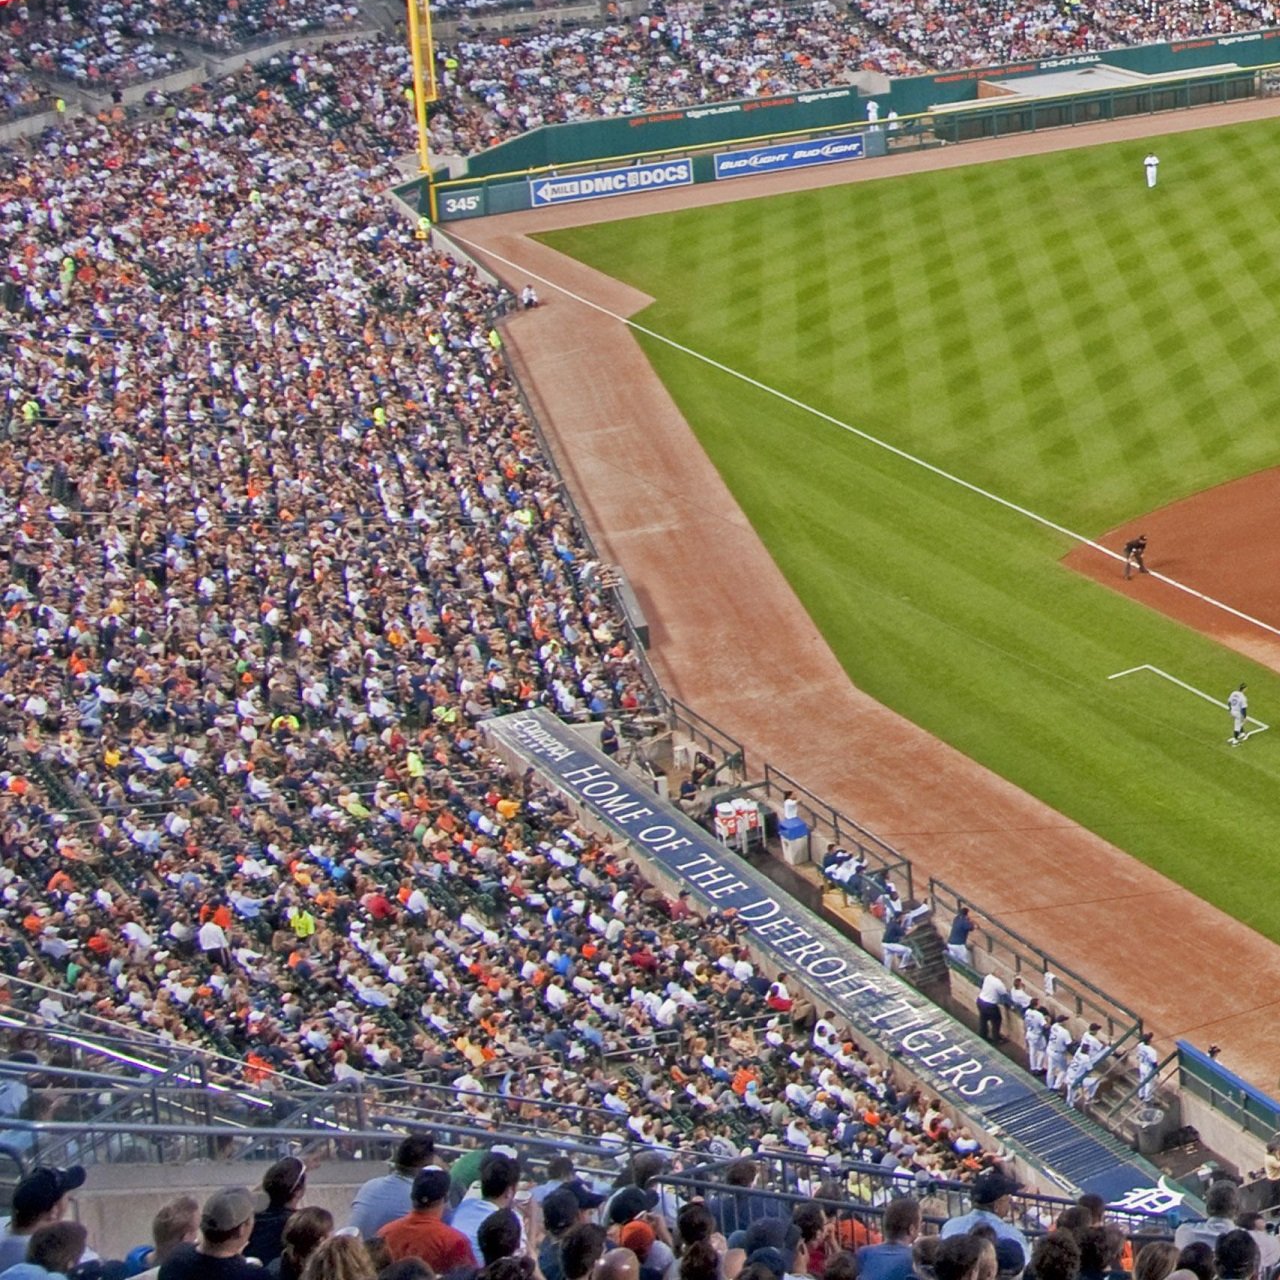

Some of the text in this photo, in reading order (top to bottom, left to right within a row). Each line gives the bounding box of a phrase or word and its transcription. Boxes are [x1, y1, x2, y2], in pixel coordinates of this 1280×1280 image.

[719, 158, 746, 170] BUD
[793, 148, 820, 160] BUD
[580, 174, 627, 194] DMC
[562, 764, 1004, 1098] HOME OF THE DETROIT TIGERS
